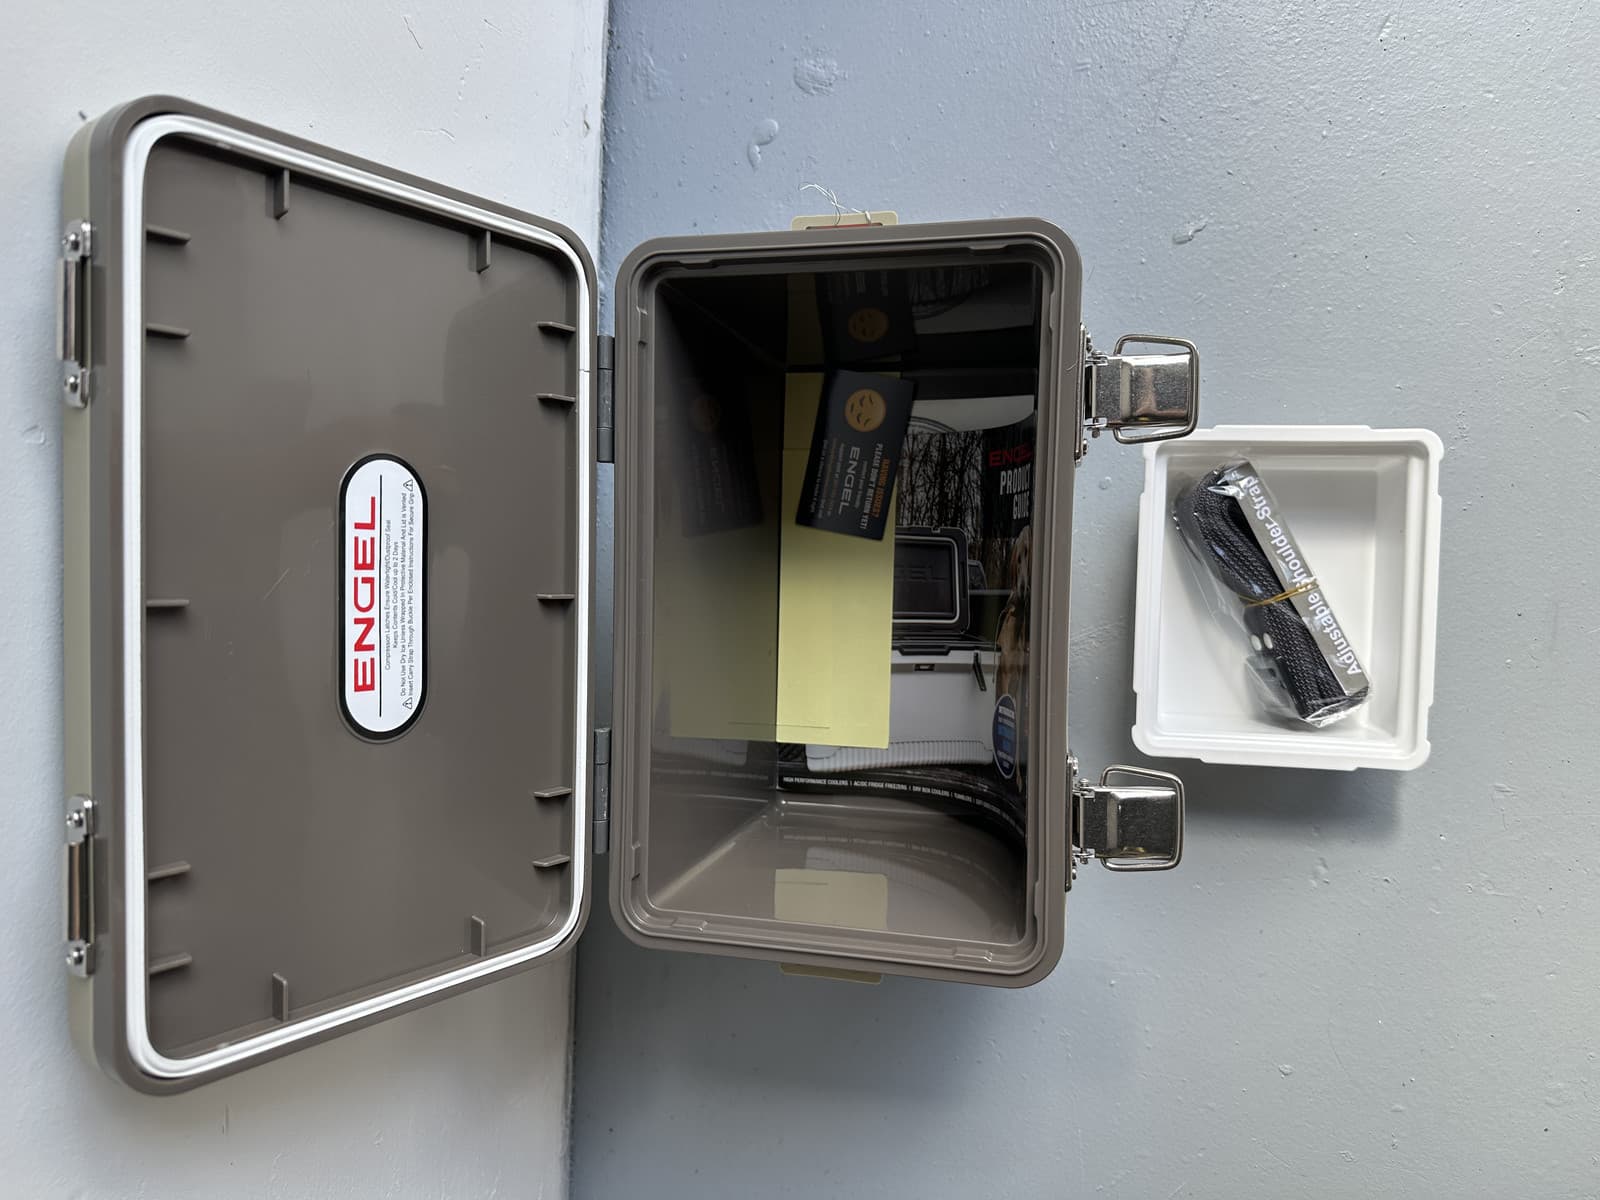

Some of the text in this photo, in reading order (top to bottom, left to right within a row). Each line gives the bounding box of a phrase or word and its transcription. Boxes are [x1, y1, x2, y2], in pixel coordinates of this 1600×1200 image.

[872, 443, 882, 466] PLEASE
[838, 446, 860, 515] ENGEL
[863, 489, 873, 512] RETURN
[1244, 477, 1270, 520] Strap
[859, 514, 868, 528] YET!
[393, 568, 399, 576] up
[354, 496, 375, 692] ENGEL
[1307, 592, 1362, 676] Adjustable
[401, 688, 406, 696] Do
[794, 777, 827, 785] PERFORMANCE
